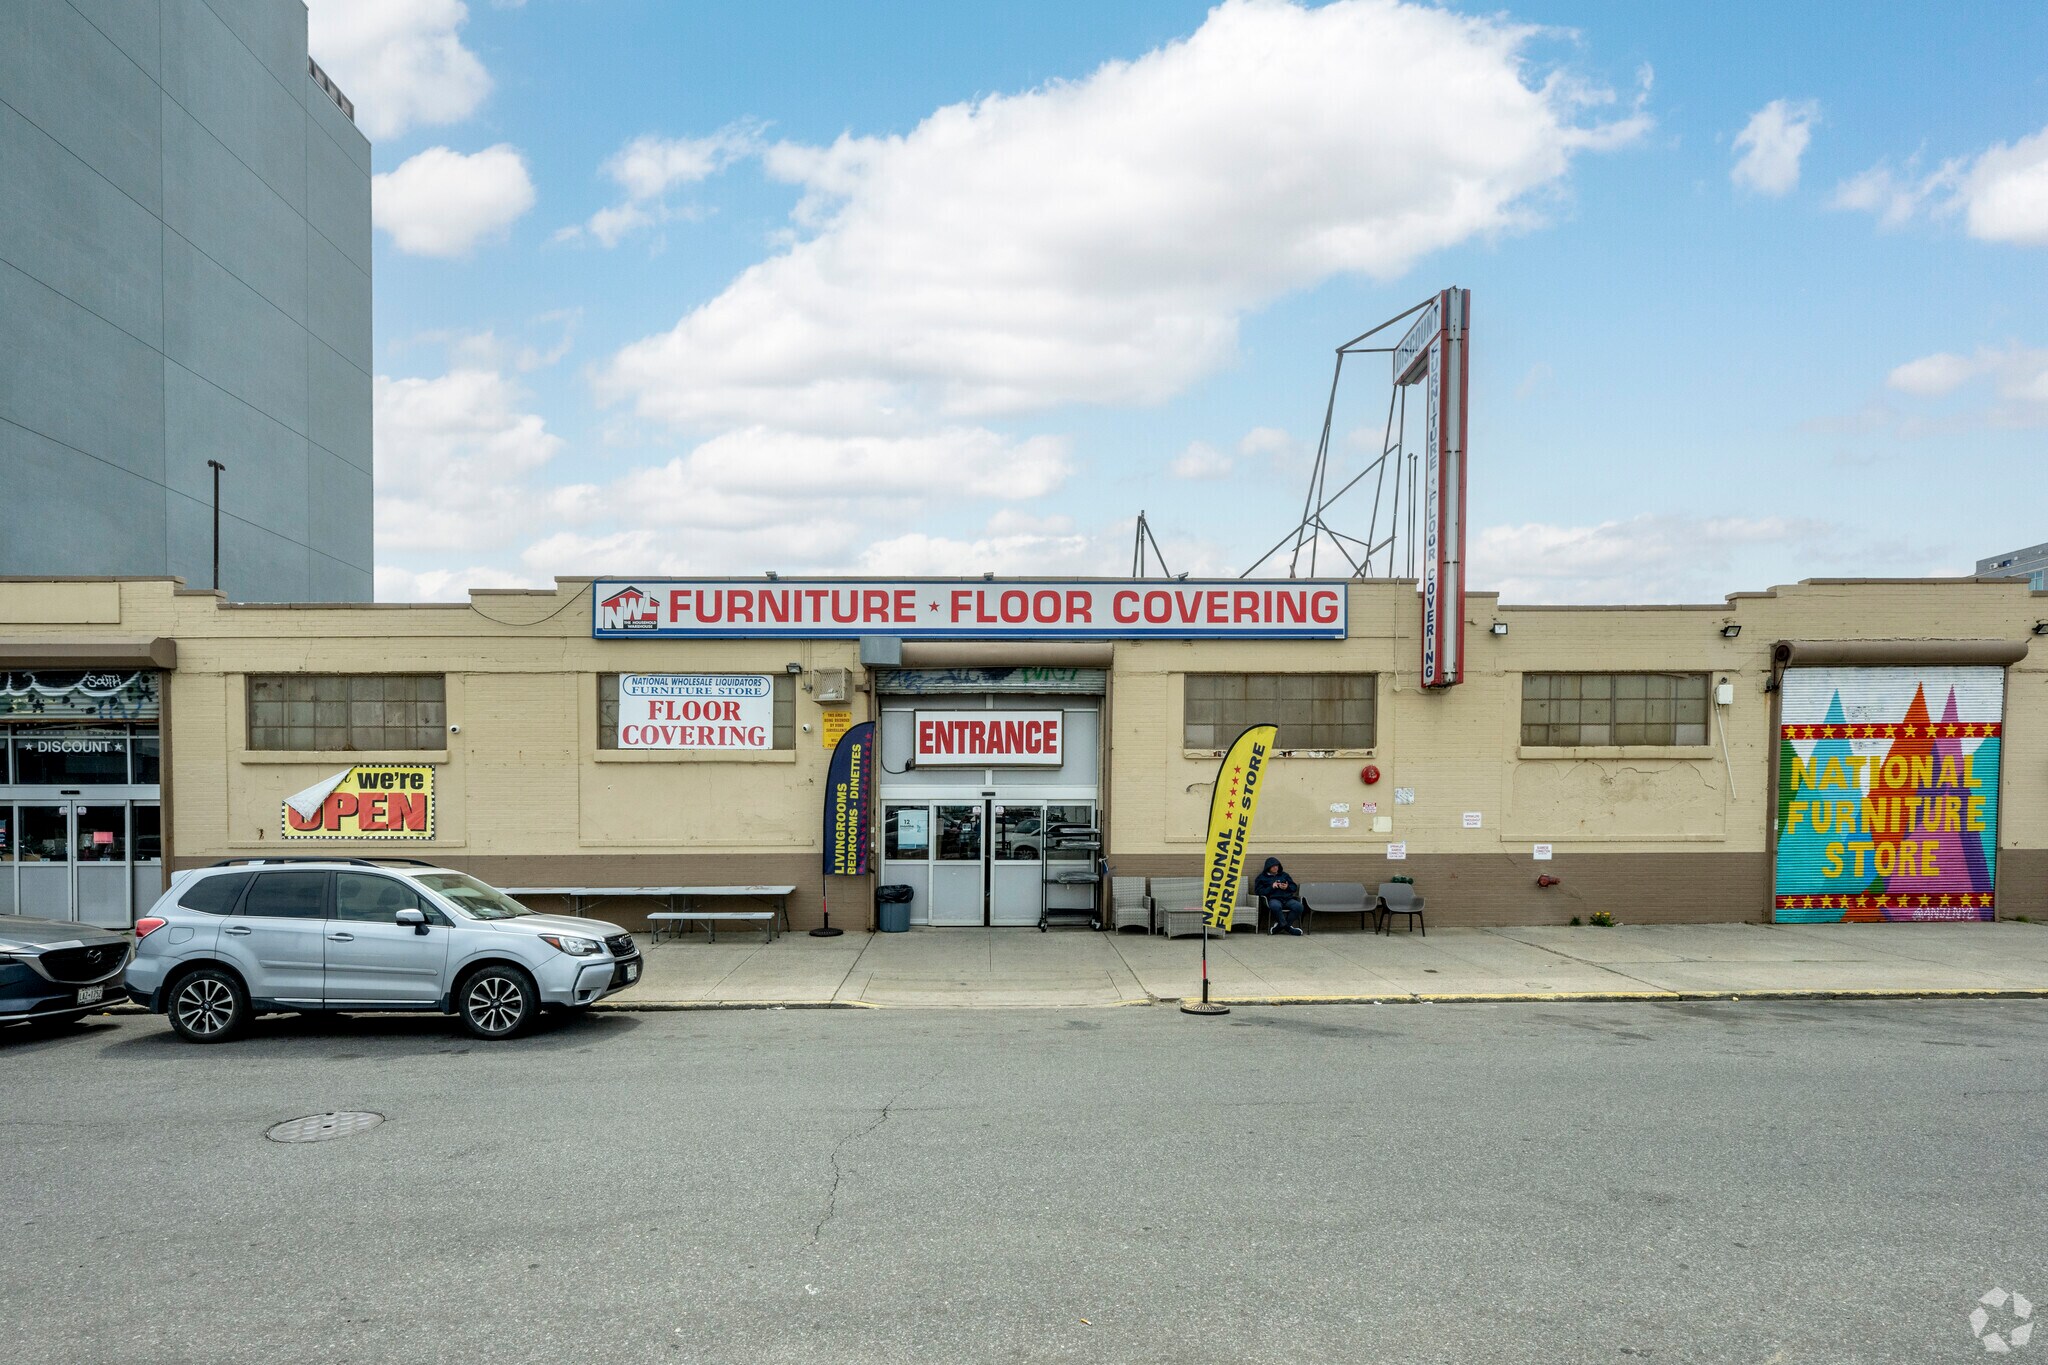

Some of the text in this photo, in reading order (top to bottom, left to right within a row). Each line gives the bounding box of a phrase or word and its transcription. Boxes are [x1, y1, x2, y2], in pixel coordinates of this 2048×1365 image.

[1396, 303, 1439, 373] DISCOUNT
[1425, 343, 1439, 678] FURNITURE FLOOR COVERING
[669, 590, 1339, 623] FURNITURE FLOOR COVERING
[631, 677, 762, 687] NATIONAL WHOLESALE LIQUIDATORS
[632, 686, 762, 695] FURNITURE STORE
[648, 700, 742, 721] FLOOR
[37, 741, 111, 753] DISCOUNT
[622, 724, 766, 746] COVERING
[919, 721, 1057, 754] ENTRANCE
[357, 771, 424, 789] we're
[849, 743, 862, 800] DINETTES
[1790, 754, 1983, 790] NATIONAL
[834, 783, 848, 875] LIVINGROOMS
[1787, 796, 1987, 834] FURNITURE
[847, 808, 859, 875] BEDROOMS
[1215, 742, 1266, 930] FURNITURE STORE
[1202, 828, 1233, 926] NATIONAL
[1821, 840, 1940, 878] STORE
